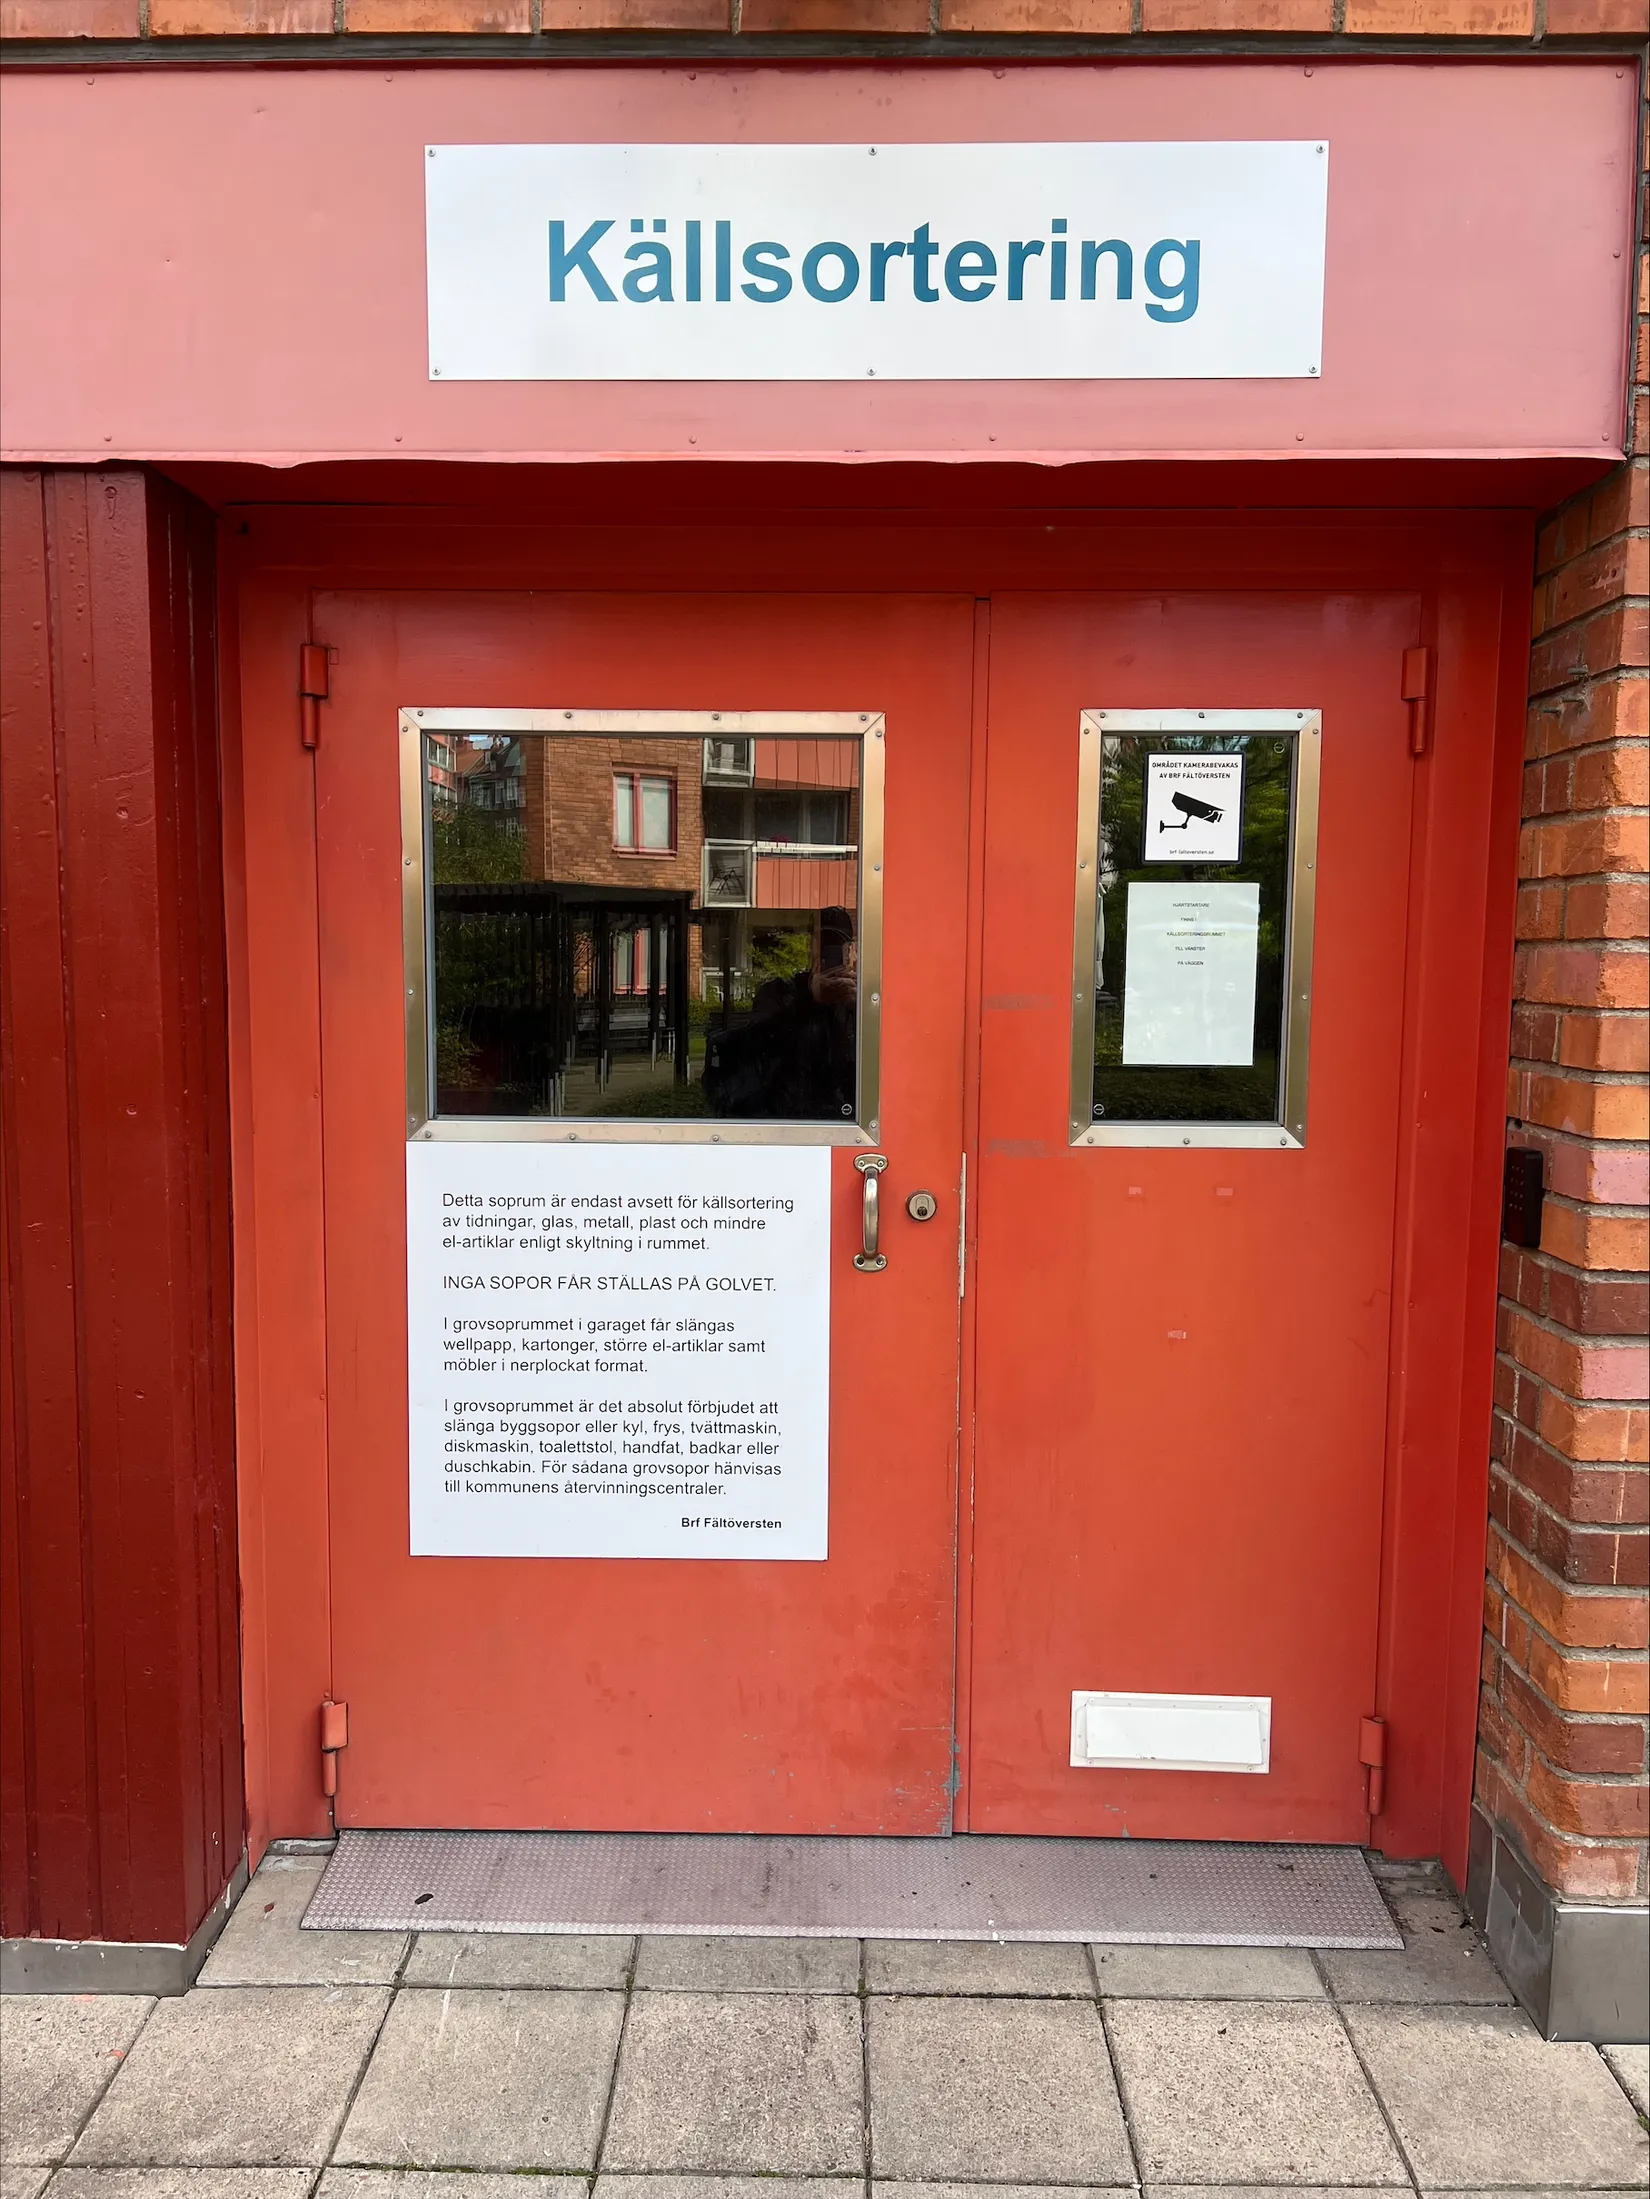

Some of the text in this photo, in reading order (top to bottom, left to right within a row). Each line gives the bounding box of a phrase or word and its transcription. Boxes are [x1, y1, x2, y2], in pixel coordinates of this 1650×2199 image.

[548, 218, 1202, 324] Källsortering
[1151, 760, 1182, 769] OMRÅDET
[442, 1192, 794, 1214] Detta soprum är endast avsett för källsortering
[442, 1213, 766, 1232] av tidningar, glas, metall, plast och mindre
[442, 1234, 515, 1249] el-artiklar
[519, 1234, 562, 1253] enligt
[565, 1235, 633, 1253] skyltning
[646, 1237, 710, 1250] rummet.
[443, 1273, 776, 1292] INGA SOPOR FÅR STÄLLAS PÅ GOLVET.
[452, 1318, 574, 1334] grovsoprummet
[586, 1318, 646, 1335] garaget
[650, 1317, 672, 1332] får
[675, 1318, 735, 1336] slängas
[442, 1336, 766, 1355] wellpapp, kartonger, större el-artiklar samt
[443, 1357, 498, 1372] möbler
[510, 1358, 591, 1375] nerplockat
[594, 1358, 648, 1373] format.
[453, 1399, 574, 1416] grovsoprummet
[578, 1398, 595, 1413] är
[598, 1399, 623, 1414] det
[627, 1399, 684, 1414] absolut
[686, 1399, 755, 1418] förbjudet
[759, 1401, 779, 1415] att
[444, 1418, 782, 1437] slänga byggsopor eller kyl, frys, tvättmaskin,
[444, 1438, 780, 1456] diskmaskin, toalettstol, handfat, badkar eller
[444, 1459, 782, 1478] duschkabin. För sådana grovsopor hänvisas
[444, 1479, 727, 1498] till kommunens återvinningscentraler.
[681, 1516, 782, 1529] Brf Fältöversten
